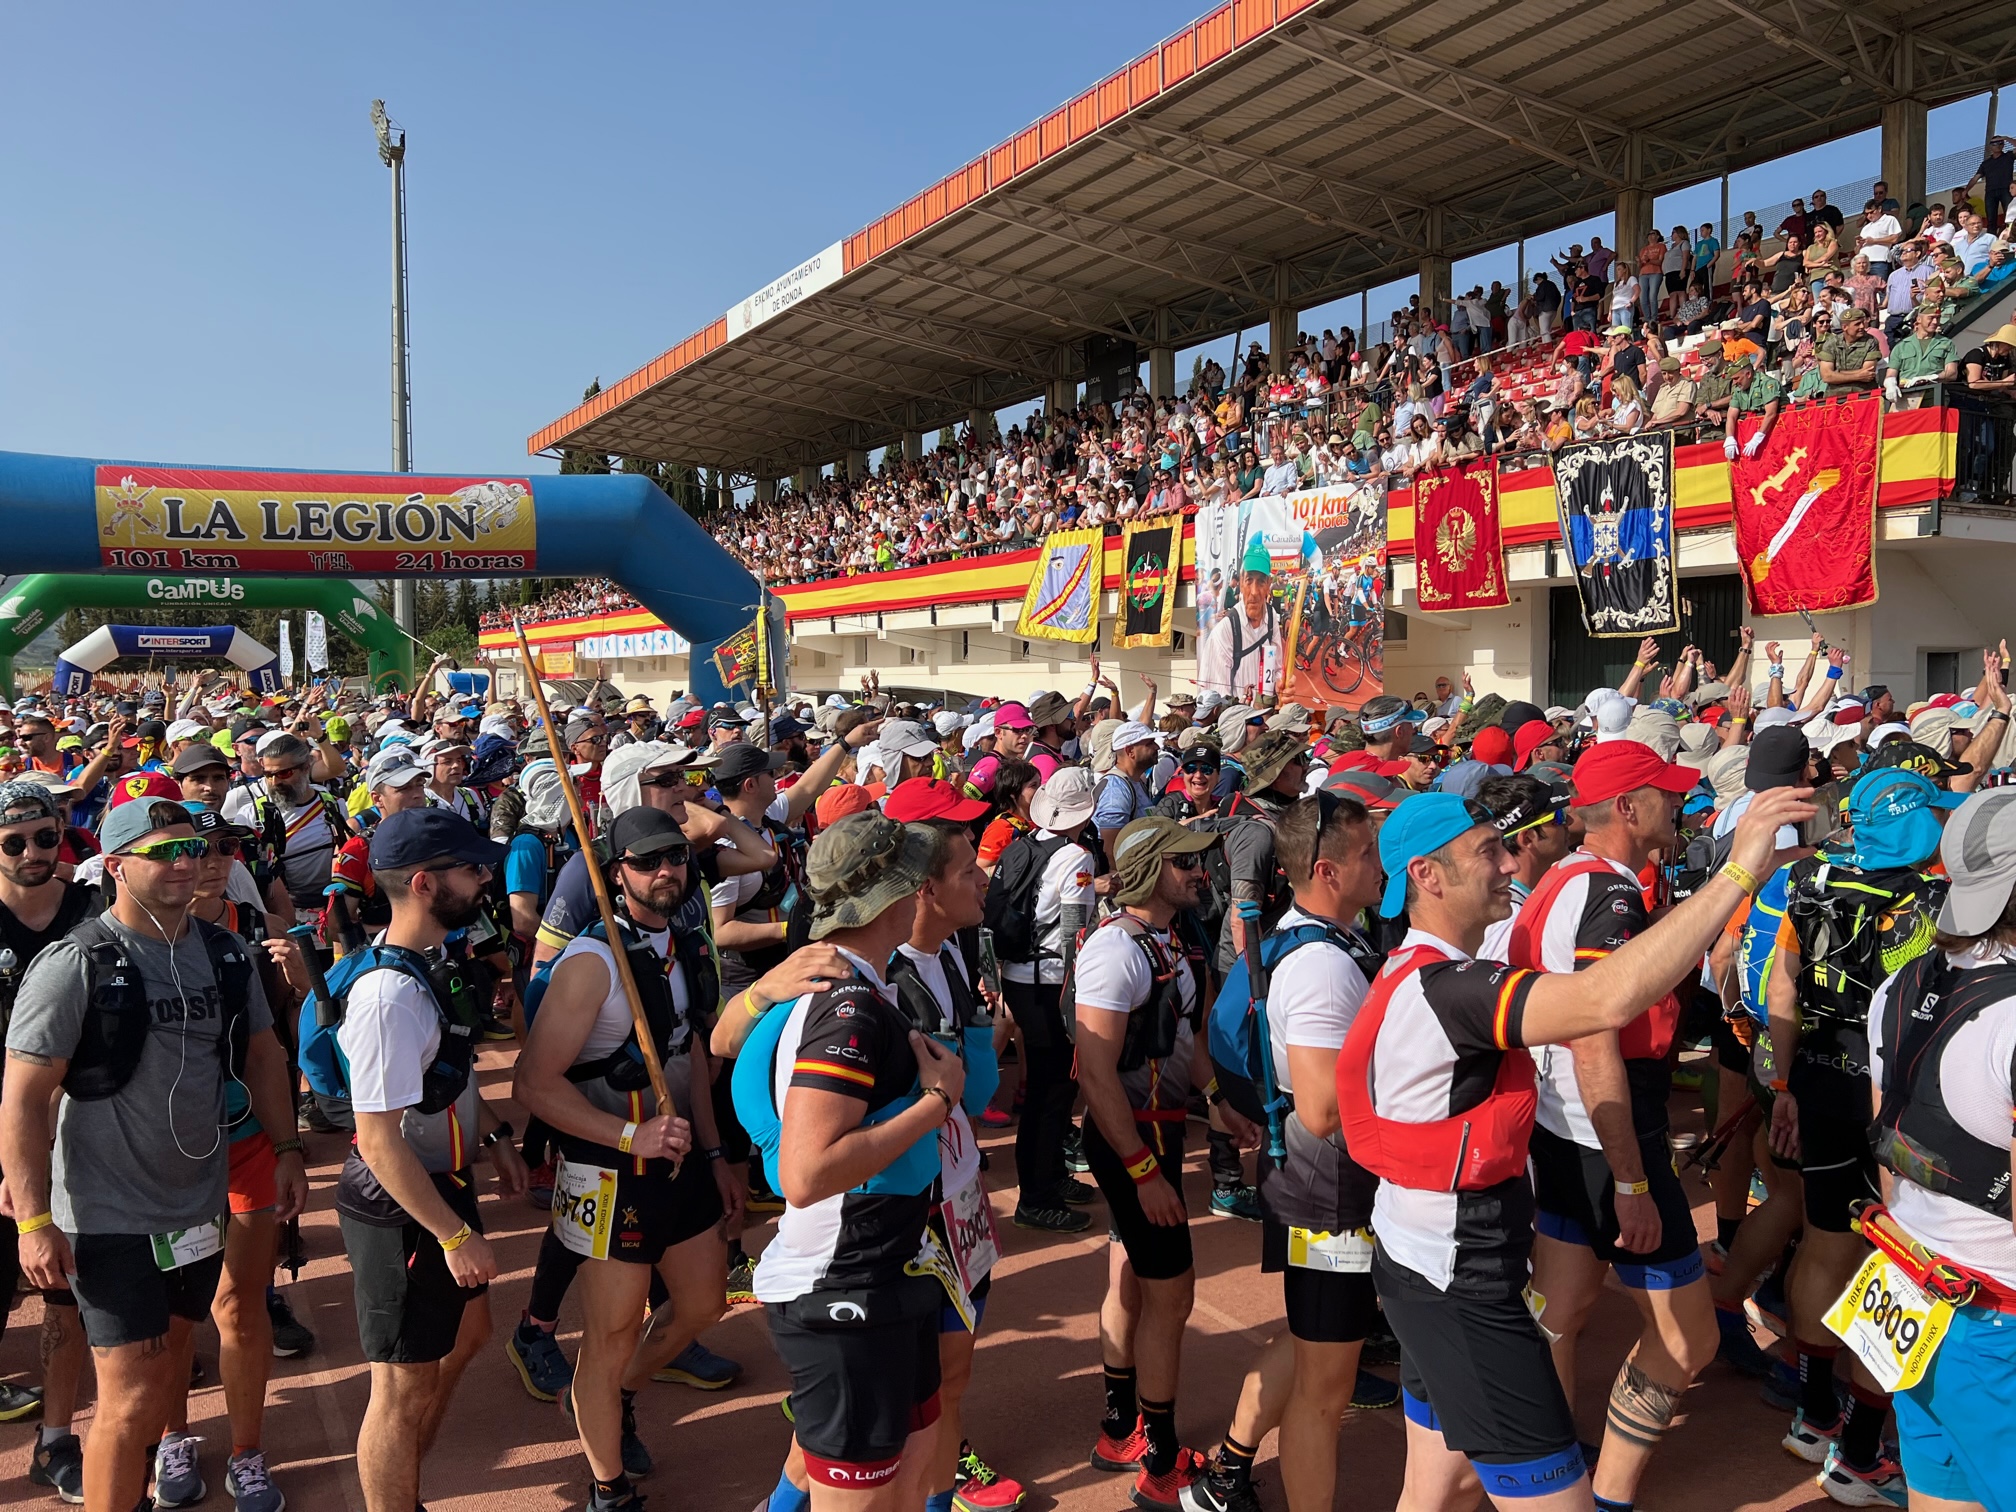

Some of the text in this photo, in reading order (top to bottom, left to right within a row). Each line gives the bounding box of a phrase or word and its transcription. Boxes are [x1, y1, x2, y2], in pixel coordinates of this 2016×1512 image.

[776, 257, 821, 292] AYUNTAMIENTO
[773, 286, 803, 312] DE RONDA
[161, 493, 477, 541] LA LEGIÓN
[1293, 492, 1348, 520] 101 km
[1303, 513, 1349, 531] 24 horas
[1271, 532, 1302, 544] CaixaBank
[110, 549, 240, 569] 101 km
[396, 550, 524, 570] 24 horas
[151, 637, 207, 646] INTERSPORT
[1473, 1147, 1480, 1159] 5
[1863, 1278, 1920, 1355] 6809
[1909, 1324, 1939, 1376] XXIII EDICIÓN
